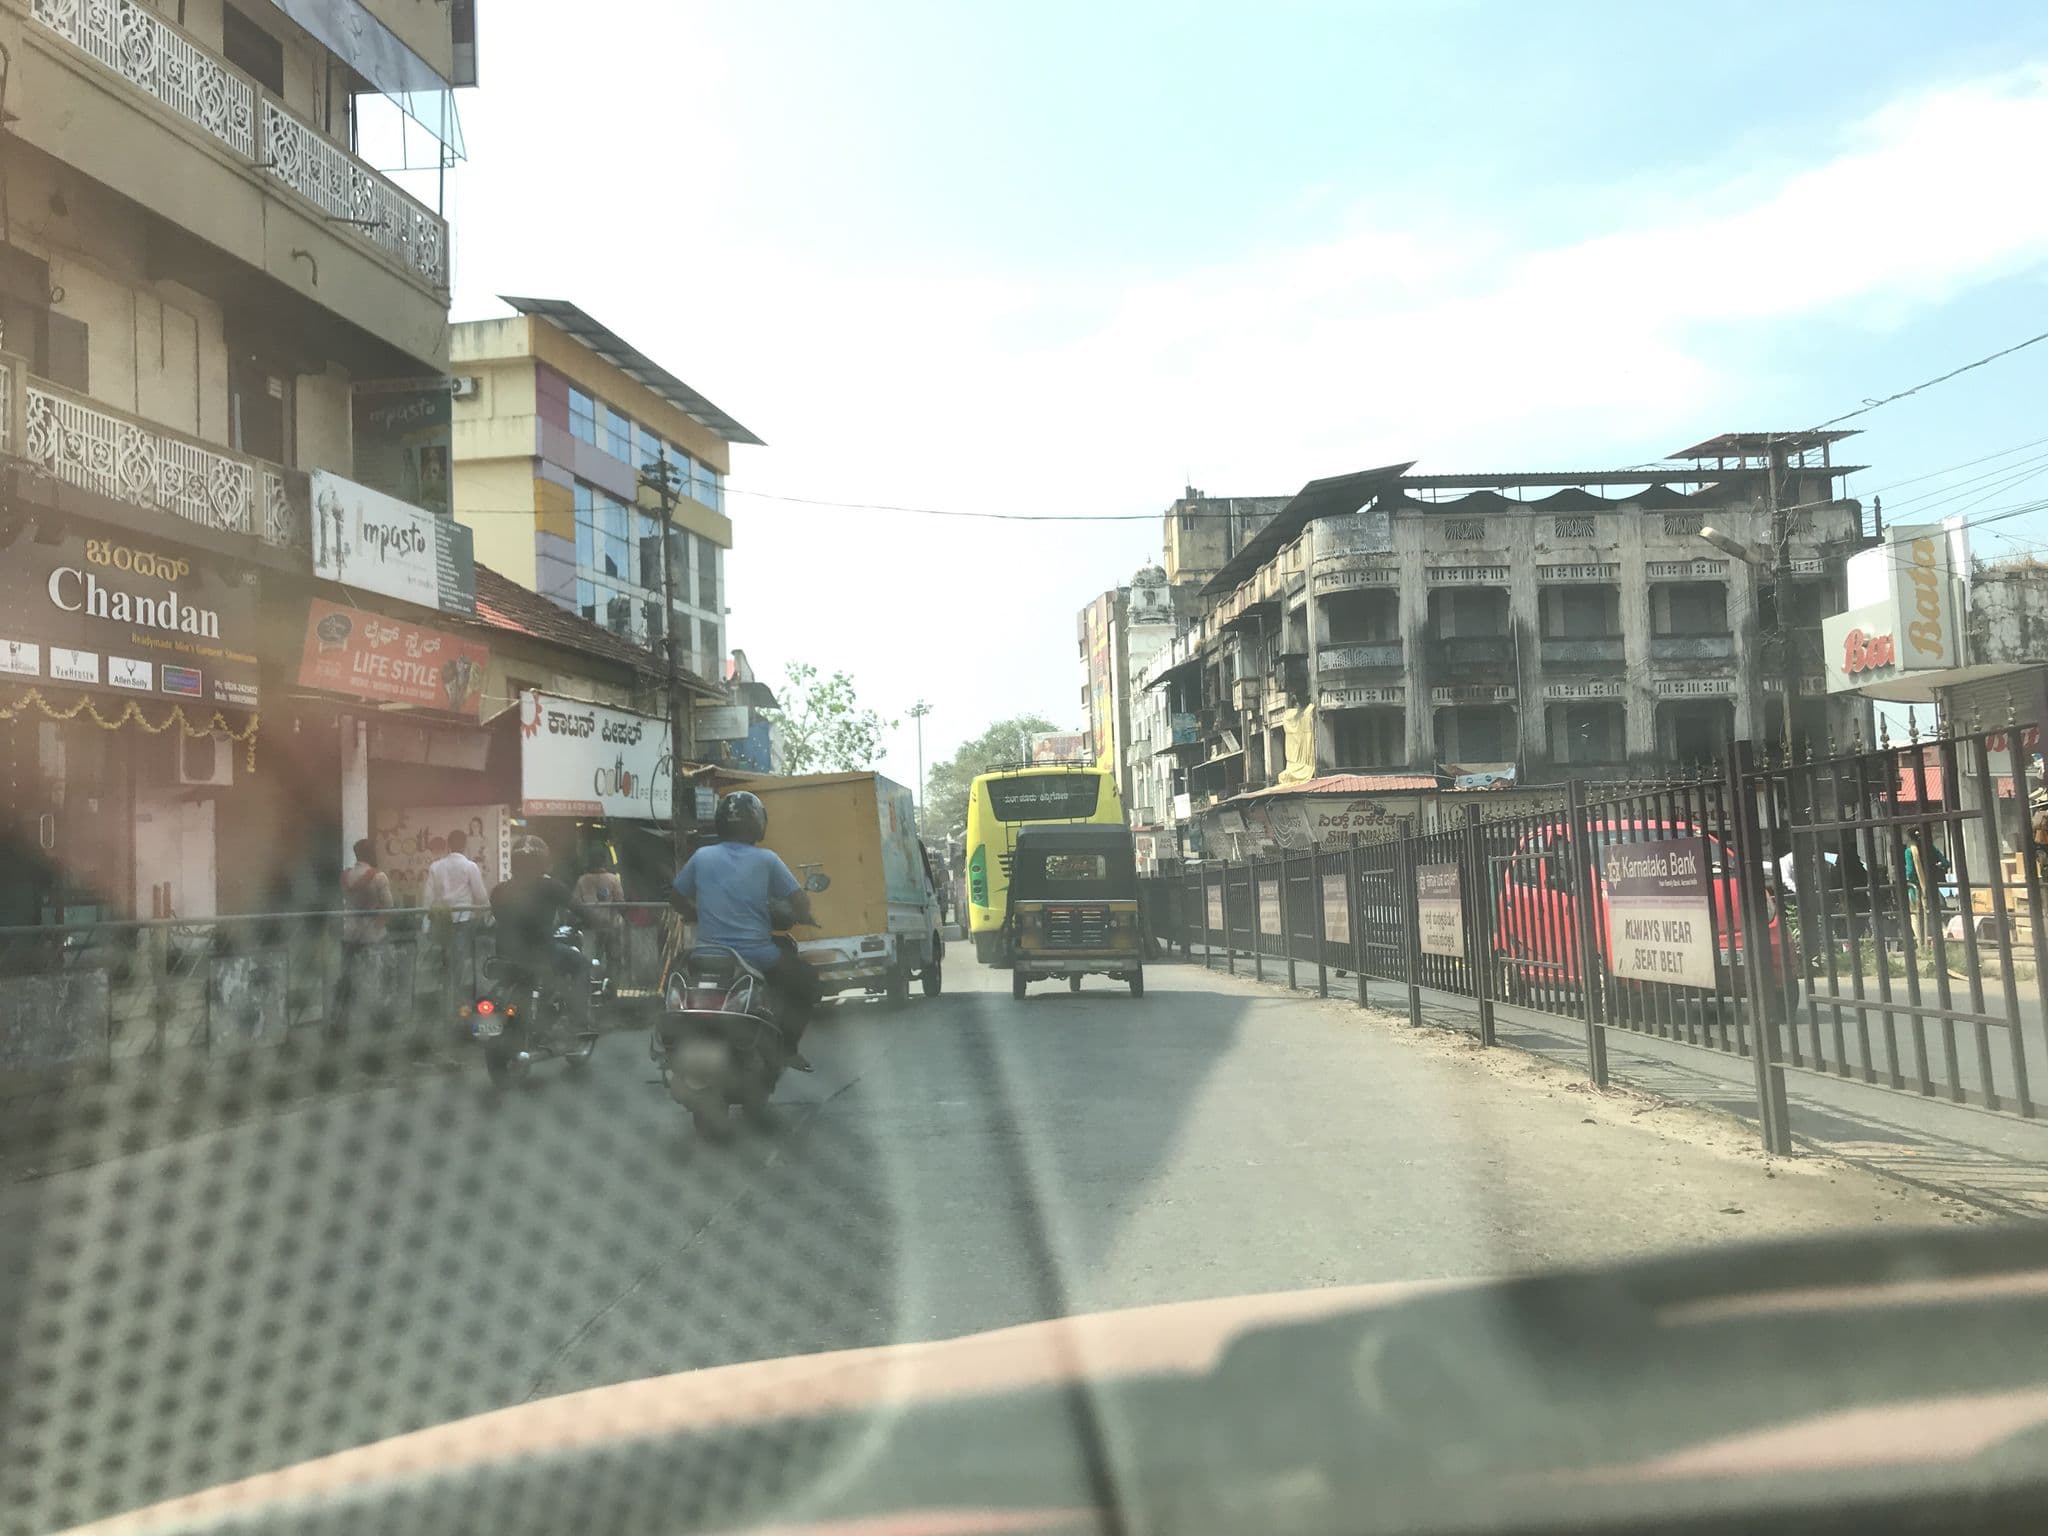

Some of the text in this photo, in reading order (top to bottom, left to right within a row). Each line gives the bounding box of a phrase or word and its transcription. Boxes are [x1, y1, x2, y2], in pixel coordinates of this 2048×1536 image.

[86, 538, 189, 581] ಚಂದನ್
[48, 567, 220, 639] Chandan
[1908, 536, 1944, 661] Bata
[113, 675, 148, 689] Allen Solly
[353, 650, 387, 678] LIFE
[390, 661, 439, 687] STYLE
[548, 711, 595, 738] ಕಾಟನ್
[1621, 850, 1697, 879] Karnataka Bank
[1626, 919, 1693, 944] ALWAYS WEAR
[1634, 948, 1684, 974] SEAT BELT
